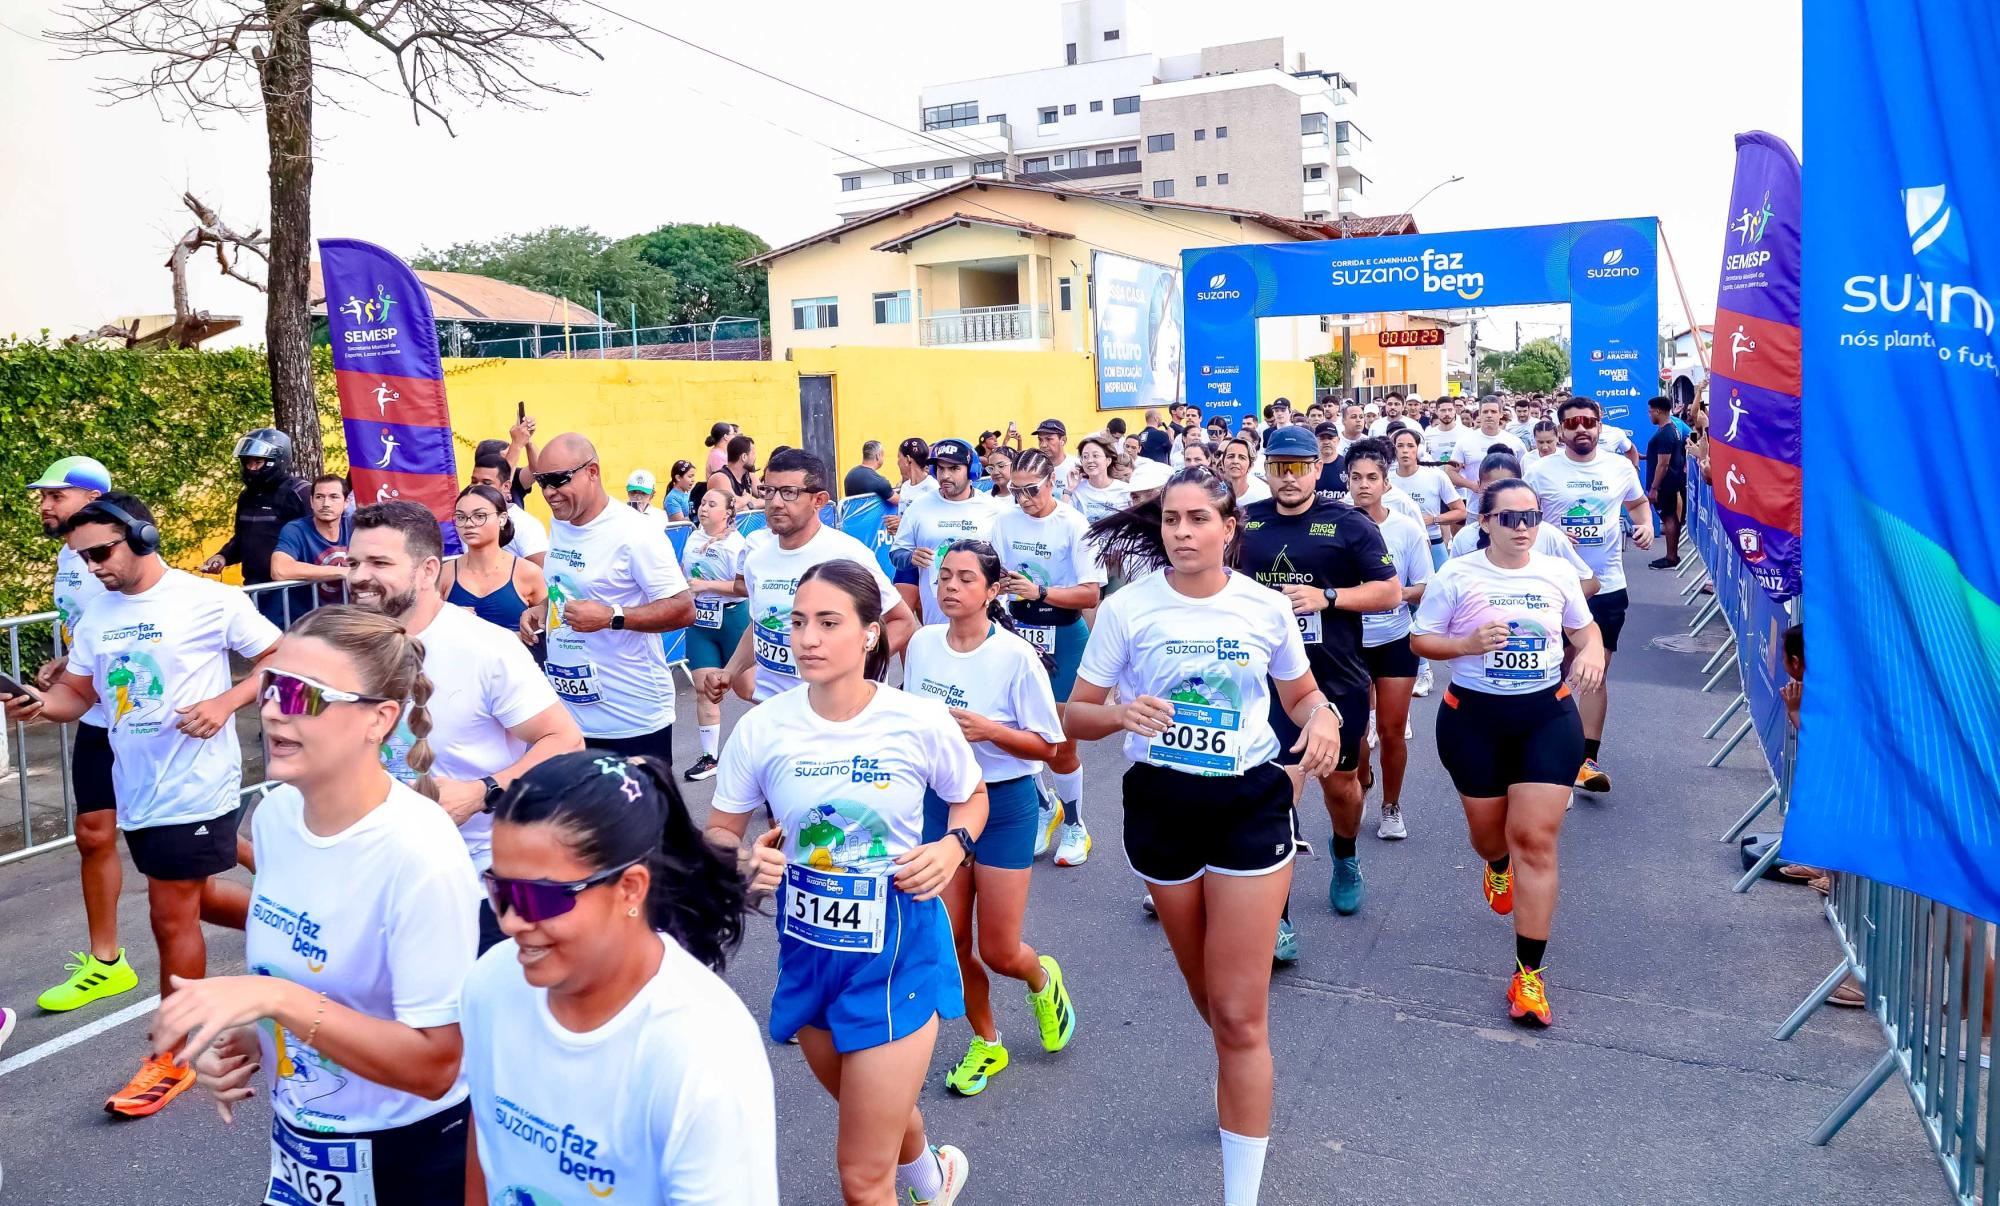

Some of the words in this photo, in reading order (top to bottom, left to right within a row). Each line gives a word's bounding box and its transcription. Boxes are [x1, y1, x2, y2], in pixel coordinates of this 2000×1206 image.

[1332, 259, 1365, 267] CORRIDA
[1374, 256, 1418, 265] CAMINHADA
[1421, 249, 1463, 272] faz
[1726, 251, 1770, 270] SEMESP
[1332, 266, 1419, 286] suzano
[1587, 267, 1640, 279] suzano
[1423, 272, 1484, 293] bem
[1197, 290, 1241, 301] suzano
[344, 327, 398, 343] SEMESP
[1607, 353, 1638, 361] ARACRUZ
[1840, 330, 1878, 346] nós
[1939, 347, 1951, 361] o
[1958, 346, 1999, 377] fut
[1207, 382, 1231, 390] POWER
[1596, 387, 1628, 398] crystal
[1205, 400, 1233, 409] crystal
[1314, 489, 1346, 500] etano
[1012, 543, 1035, 552] suzano
[1035, 541, 1047, 550] faz
[571, 549, 582, 560] faz
[1035, 549, 1052, 557] bem
[569, 559, 586, 568] bem
[1255, 571, 1313, 584] NUTRIPRO
[762, 582, 789, 591] suzano
[1489, 598, 1526, 606] suzano
[1525, 593, 1542, 602] faz
[1527, 601, 1550, 609] bem
[696, 609, 715, 621] 042
[138, 623, 156, 633] faz
[102, 629, 139, 642] suzano
[138, 631, 163, 641] bem
[1018, 629, 1045, 643] 118
[1216, 637, 1240, 649] faz
[757, 637, 789, 663] 5879
[1166, 645, 1216, 655] suzano
[1218, 649, 1251, 660] bem
[1493, 651, 1539, 669] 5083
[554, 677, 590, 695] 5864
[921, 683, 948, 697] suzano
[948, 684, 965, 699] faz
[944, 694, 969, 708] bem
[1162, 724, 1226, 754] 6036
[851, 755, 879, 769] faz
[794, 765, 850, 777] suzano
[852, 769, 891, 783] bem
[827, 878, 839, 886] faz
[826, 885, 844, 893] bem
[795, 891, 862, 930] 5144
[253, 903, 296, 936] suzano
[297, 911, 322, 941] faz
[292, 932, 329, 964] bem
[495, 1107, 557, 1154] suzano
[561, 1124, 598, 1161] faz
[559, 1150, 616, 1186] bem
[280, 1151, 346, 1206] 5162
